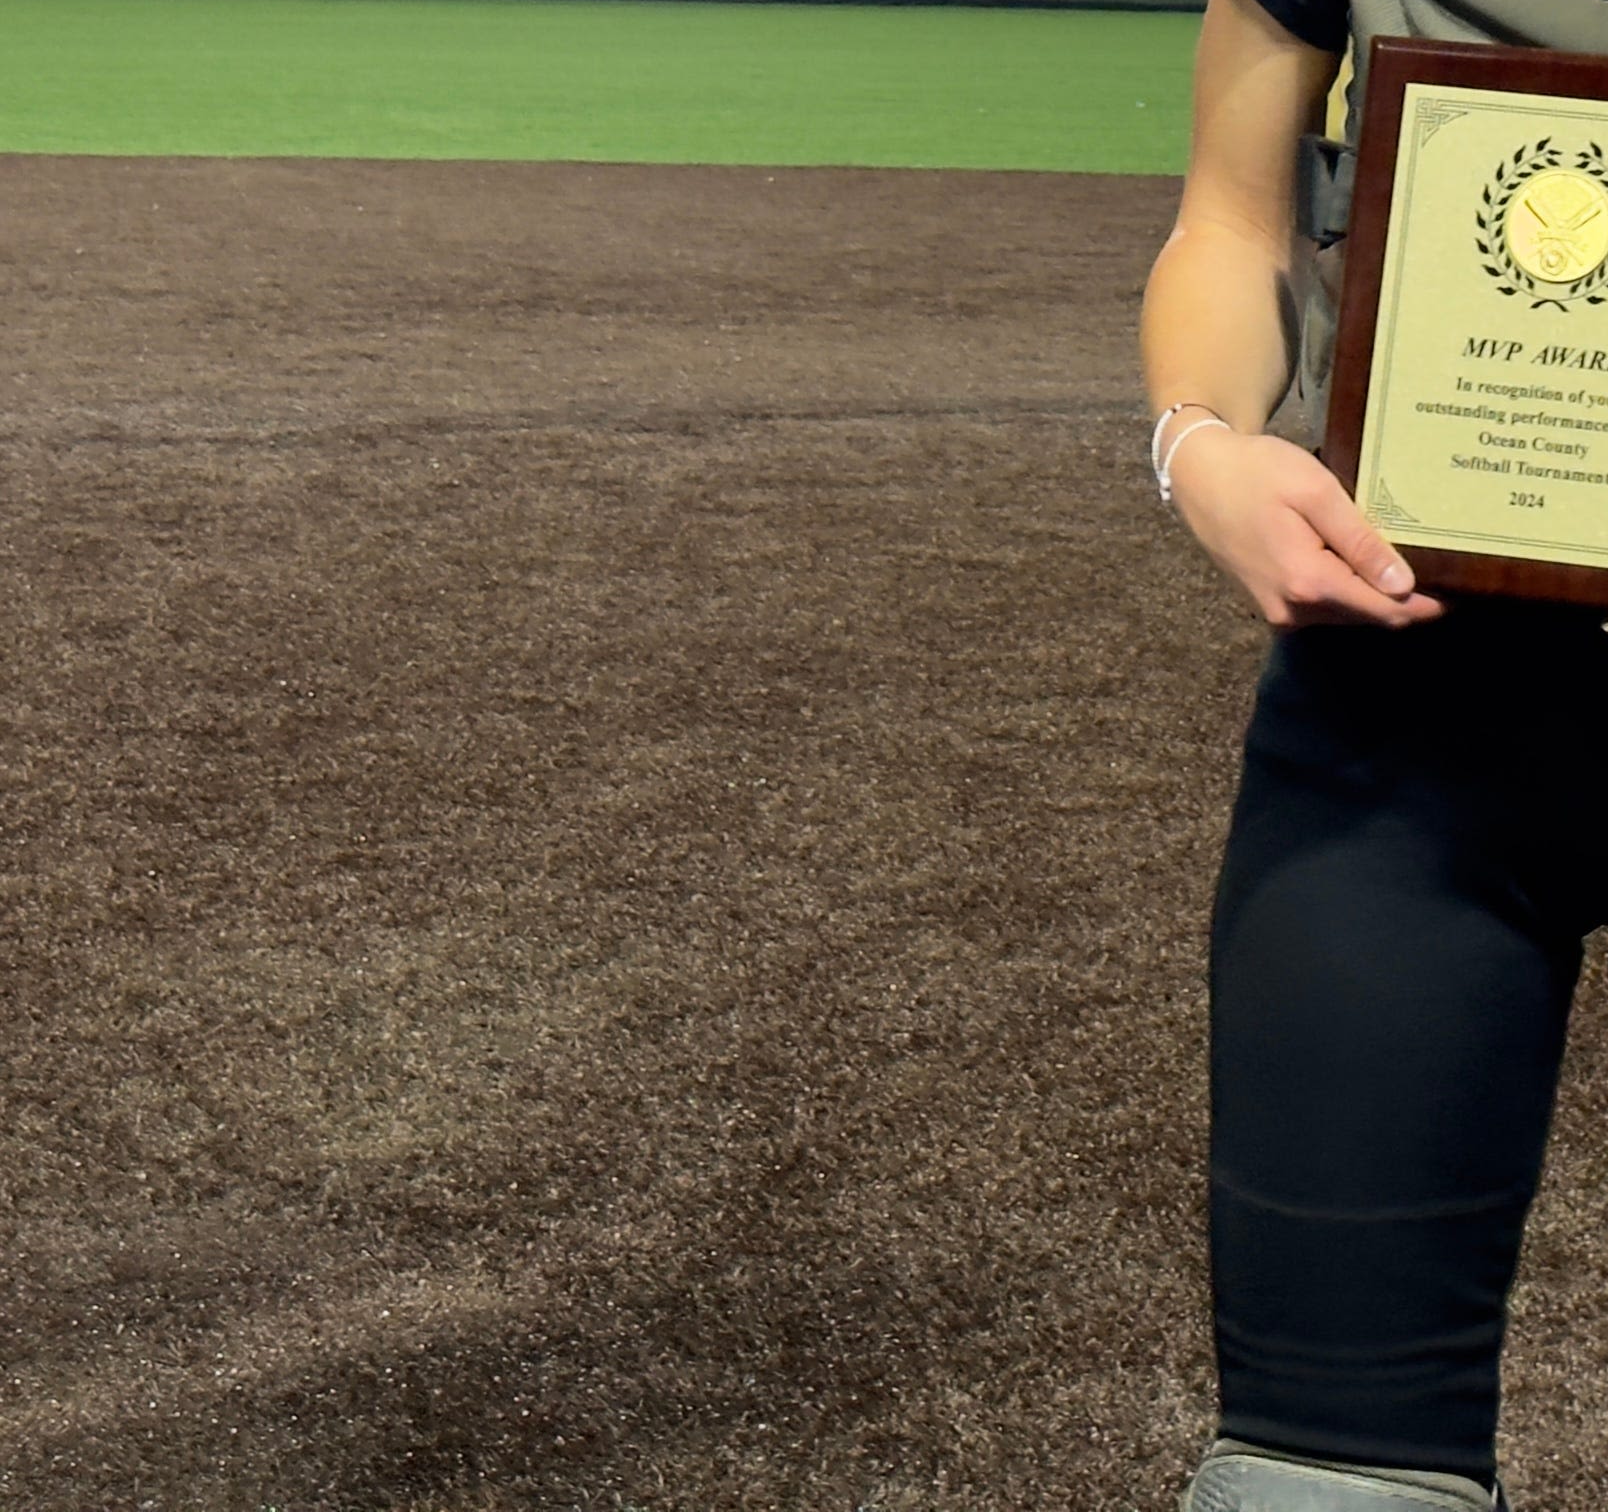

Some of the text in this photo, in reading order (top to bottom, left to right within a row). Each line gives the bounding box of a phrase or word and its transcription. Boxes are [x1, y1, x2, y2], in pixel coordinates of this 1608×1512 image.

[1461, 337, 1523, 362] MVP
[1456, 377, 1472, 392] In
[1477, 382, 1563, 401] recognition
[1568, 390, 1586, 403] of
[1415, 401, 1507, 425] outstanding
[1478, 431, 1589, 460] Ocean County
[1450, 453, 1511, 474] Softball
[1509, 491, 1545, 508] 2024
